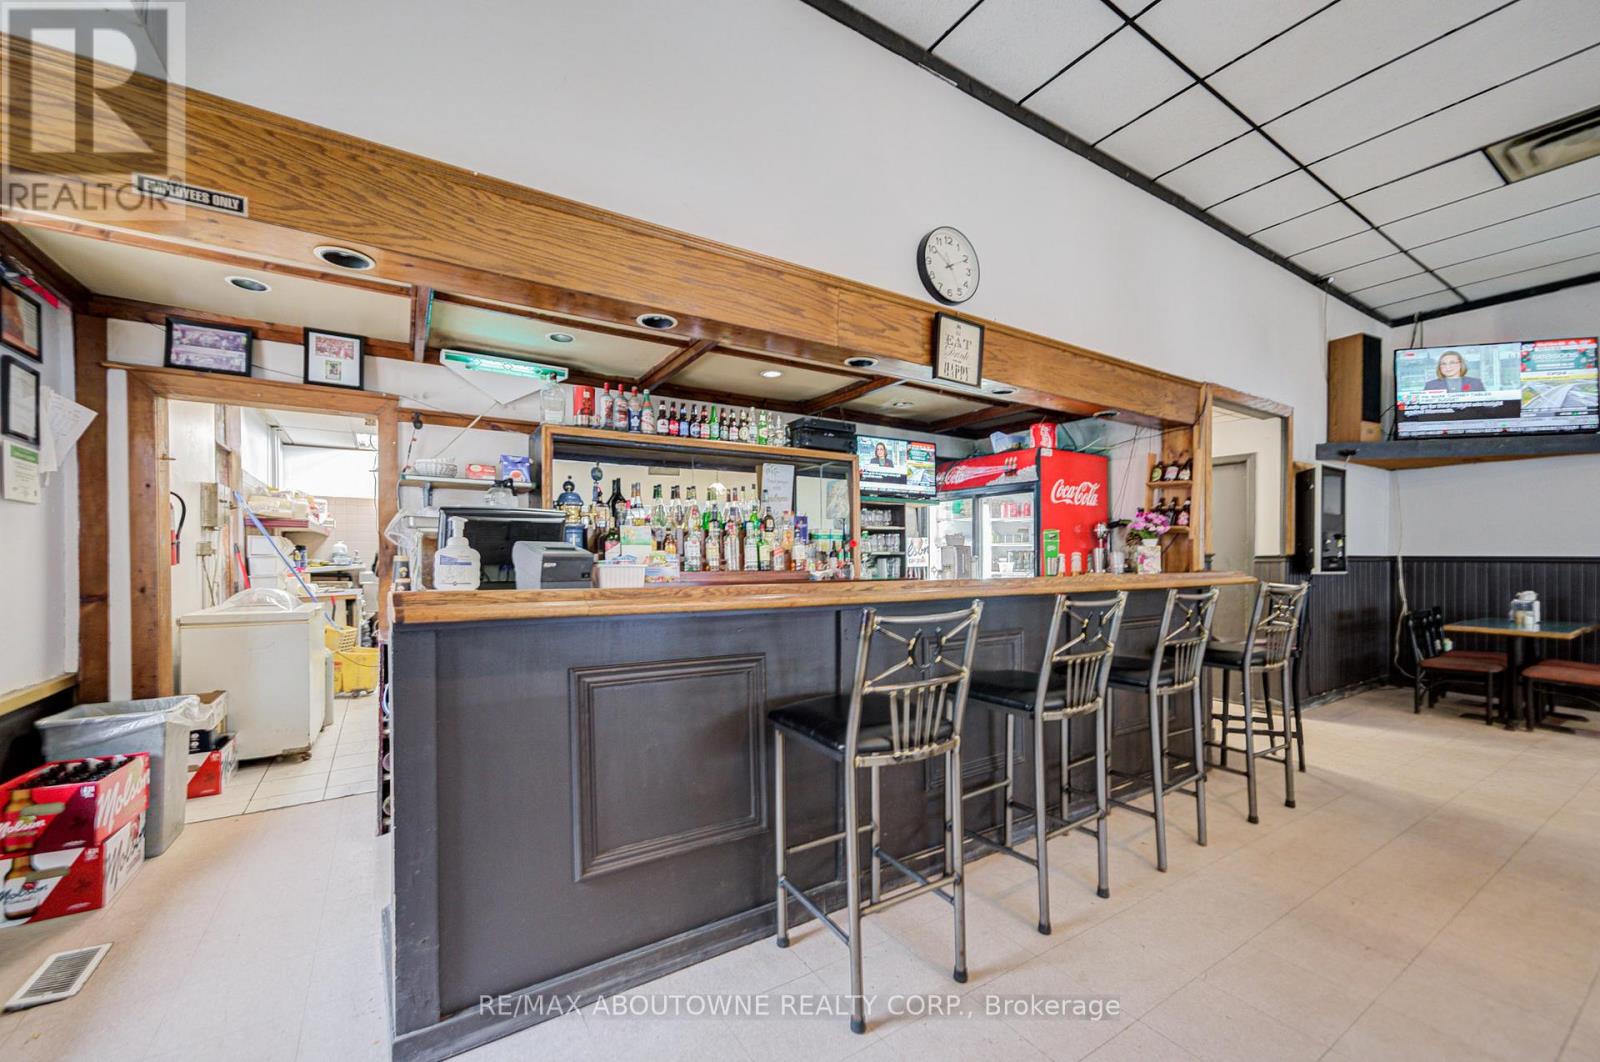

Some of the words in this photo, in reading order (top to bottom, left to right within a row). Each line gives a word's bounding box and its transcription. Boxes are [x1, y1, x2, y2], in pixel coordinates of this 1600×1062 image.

[143, 178, 210, 204] EMPLOYEES
[212, 194, 240, 210] ONLY
[936, 237, 942, 247] 11
[944, 235, 953, 246] 12
[928, 244, 937, 254] 10
[926, 256, 932, 265] 9
[962, 254, 969, 263] 2
[930, 270, 936, 280] 8
[937, 281, 944, 292] 7
[963, 281, 969, 289] 4
[947, 288, 953, 298] 6
[956, 287, 963, 297] 5
[946, 334, 973, 351] EAT
[1051, 479, 1100, 506] Coca-Cola
